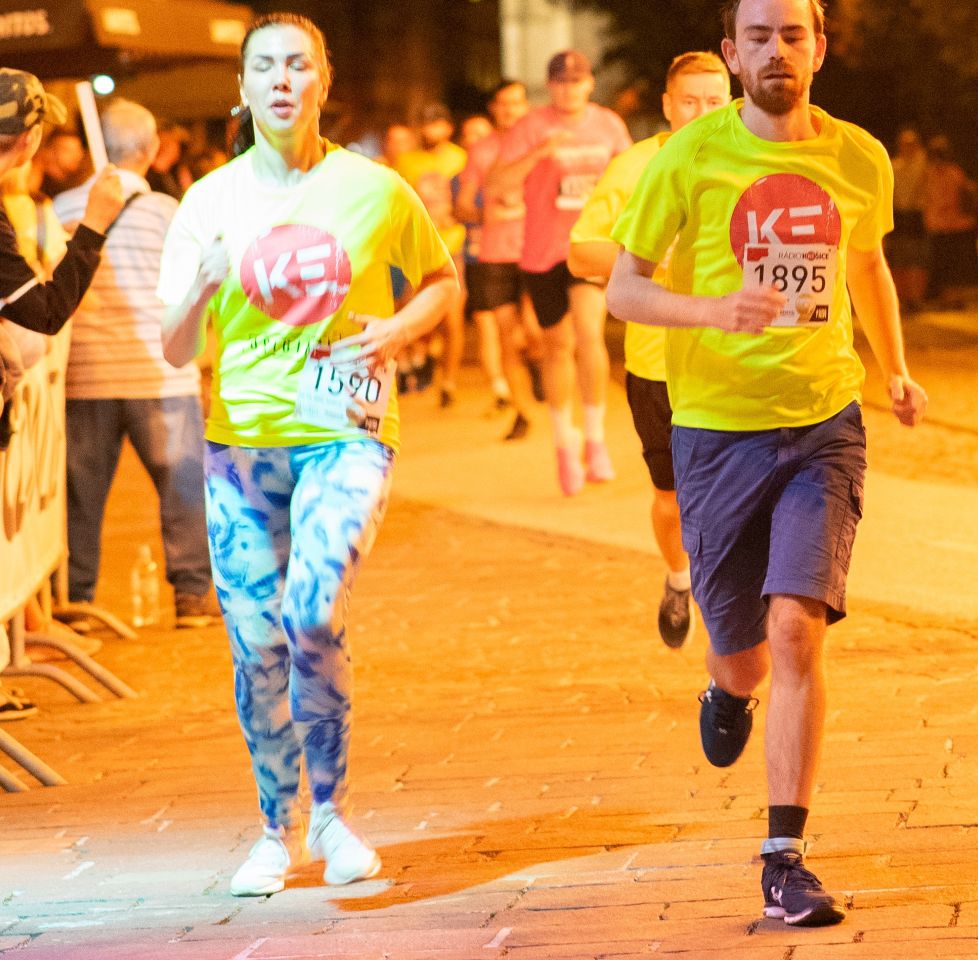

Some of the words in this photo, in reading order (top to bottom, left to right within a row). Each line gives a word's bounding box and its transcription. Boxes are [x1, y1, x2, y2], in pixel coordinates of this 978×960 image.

[253, 243, 332, 305] KE
[754, 263, 827, 293] 1895
[313, 364, 382, 404] 1590
